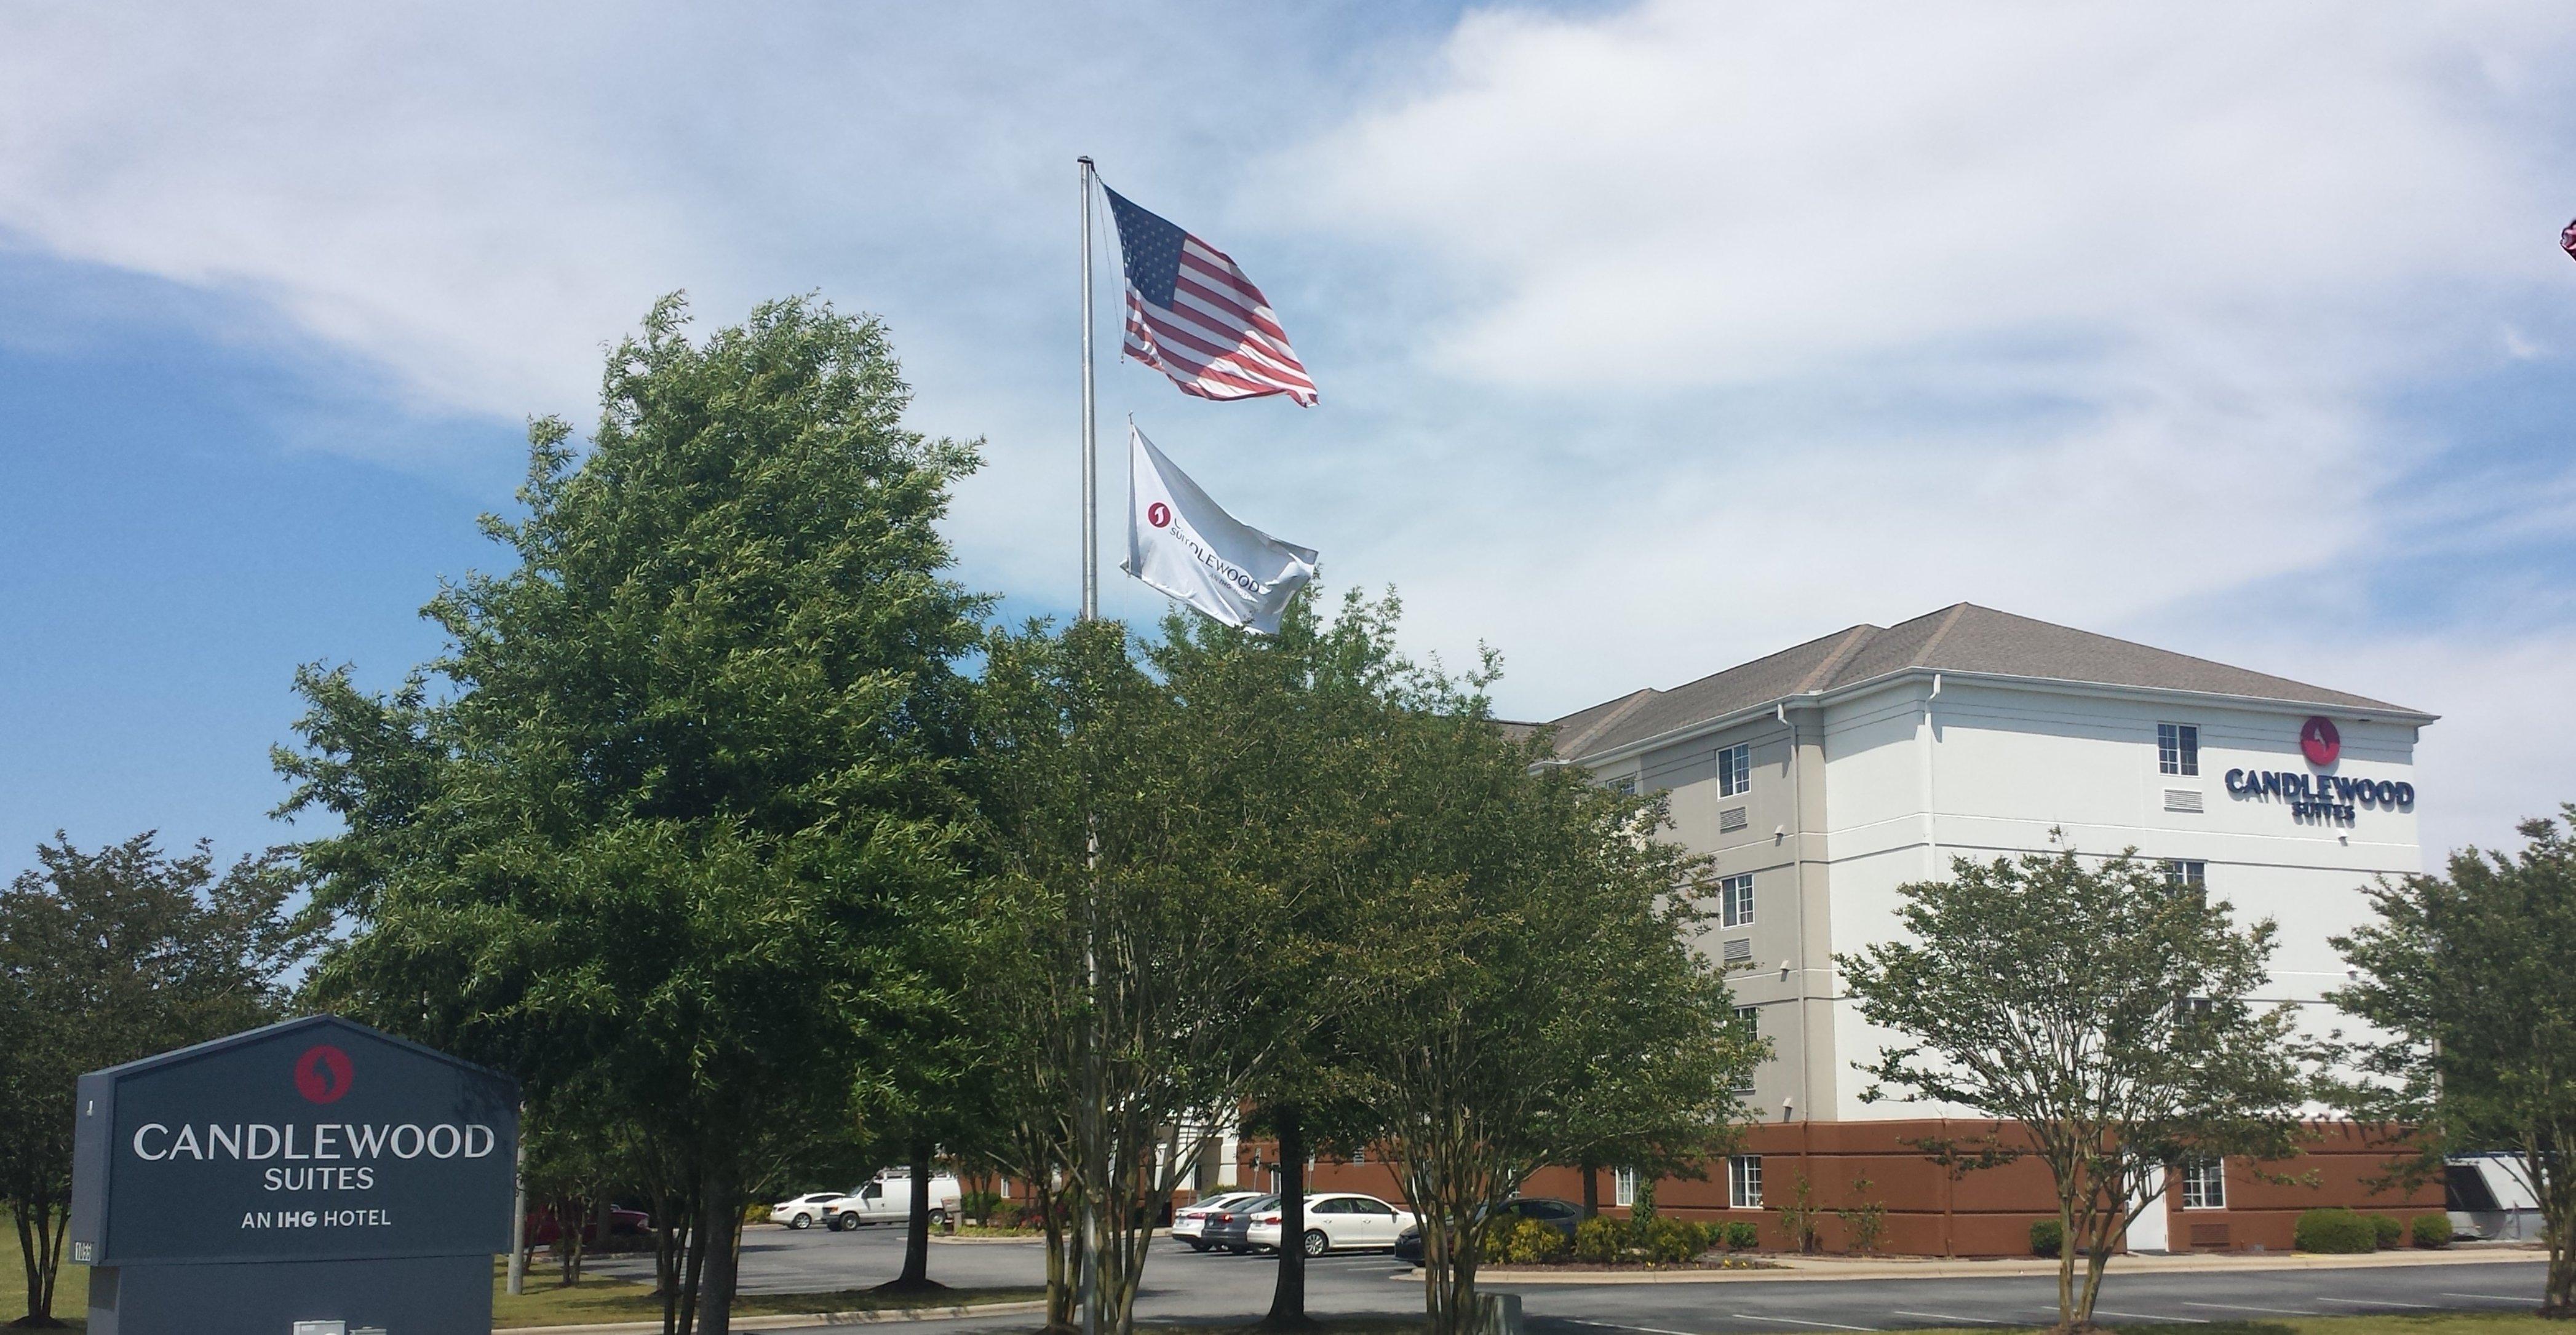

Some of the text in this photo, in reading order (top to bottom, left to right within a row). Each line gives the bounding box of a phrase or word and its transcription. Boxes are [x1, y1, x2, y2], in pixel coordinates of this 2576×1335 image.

[1170, 527, 1190, 545] SUIT
[1174, 518, 1260, 592] CDLEWOOD
[2224, 768, 2414, 806] CANDLEWOOD
[2291, 801, 2355, 821] SUITES
[133, 1123, 495, 1160] CANDLEWOOD
[264, 1167, 374, 1190] SUITES
[241, 1209, 391, 1229] AN IHG HOTEL
